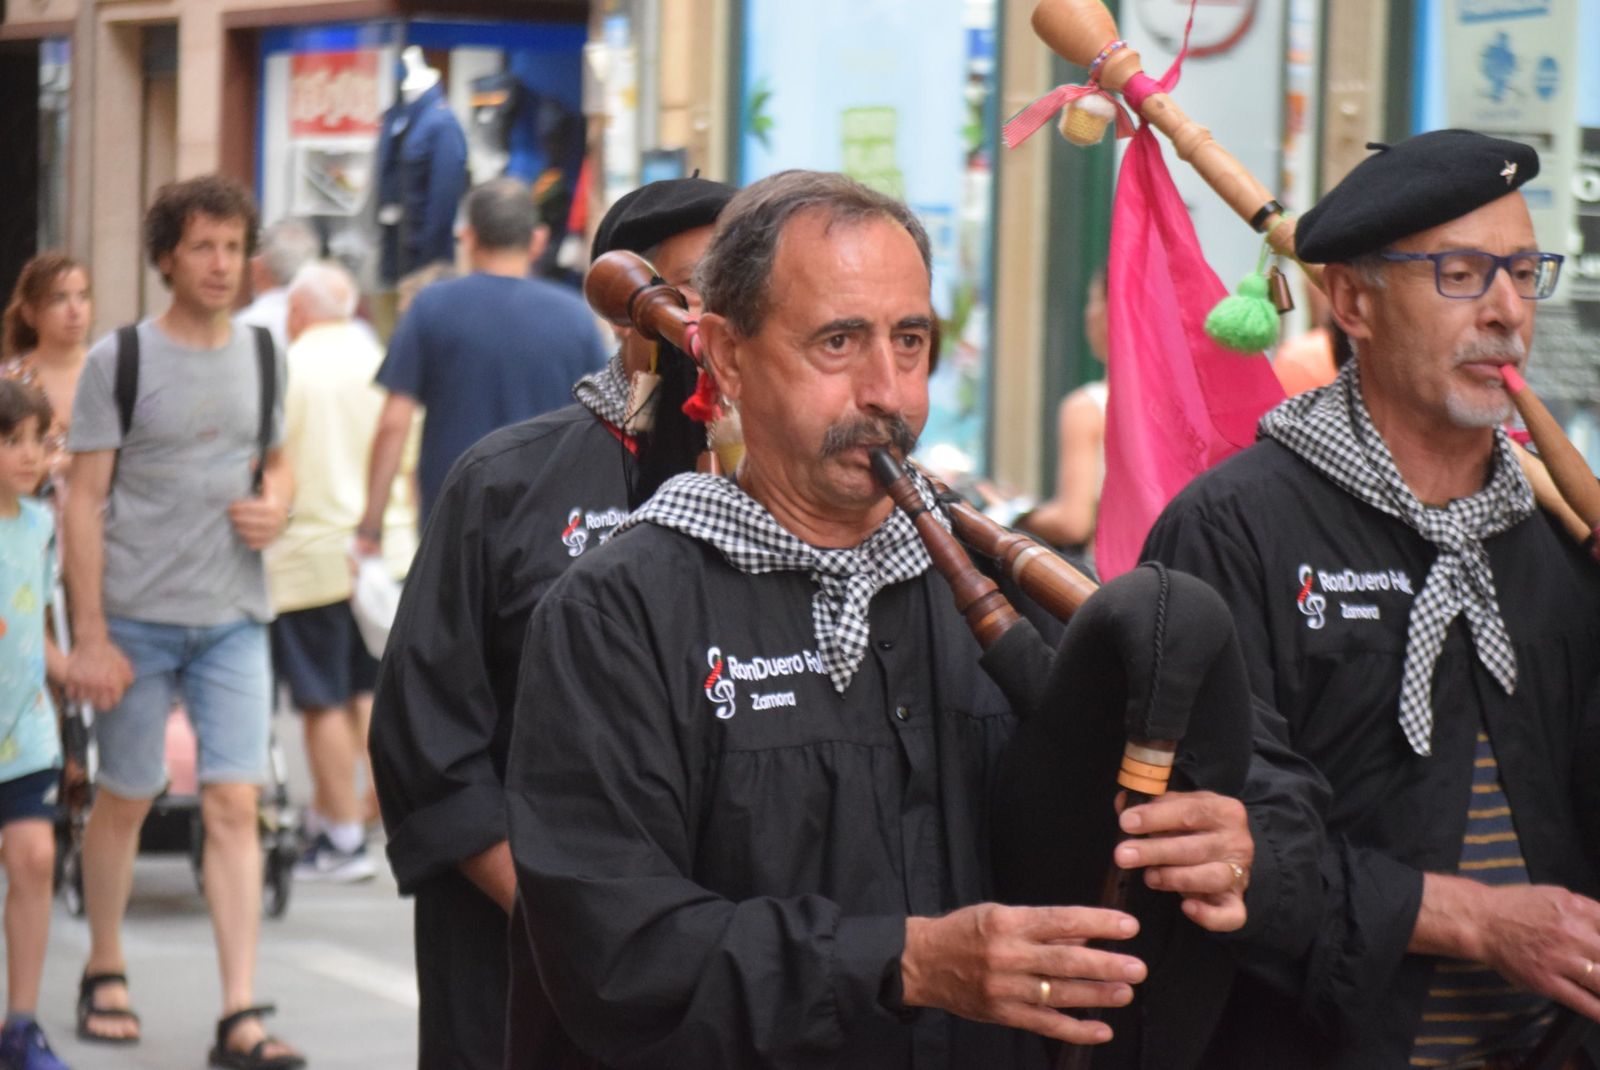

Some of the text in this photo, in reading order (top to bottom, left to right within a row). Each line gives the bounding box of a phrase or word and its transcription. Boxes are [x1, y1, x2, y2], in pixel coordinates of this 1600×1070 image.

[585, 509, 629, 529] RonDu
[1317, 569, 1391, 593] RonDuero
[1339, 601, 1381, 620] Zamora
[727, 653, 805, 681] RonDuero
[750, 691, 797, 711] Zamora
